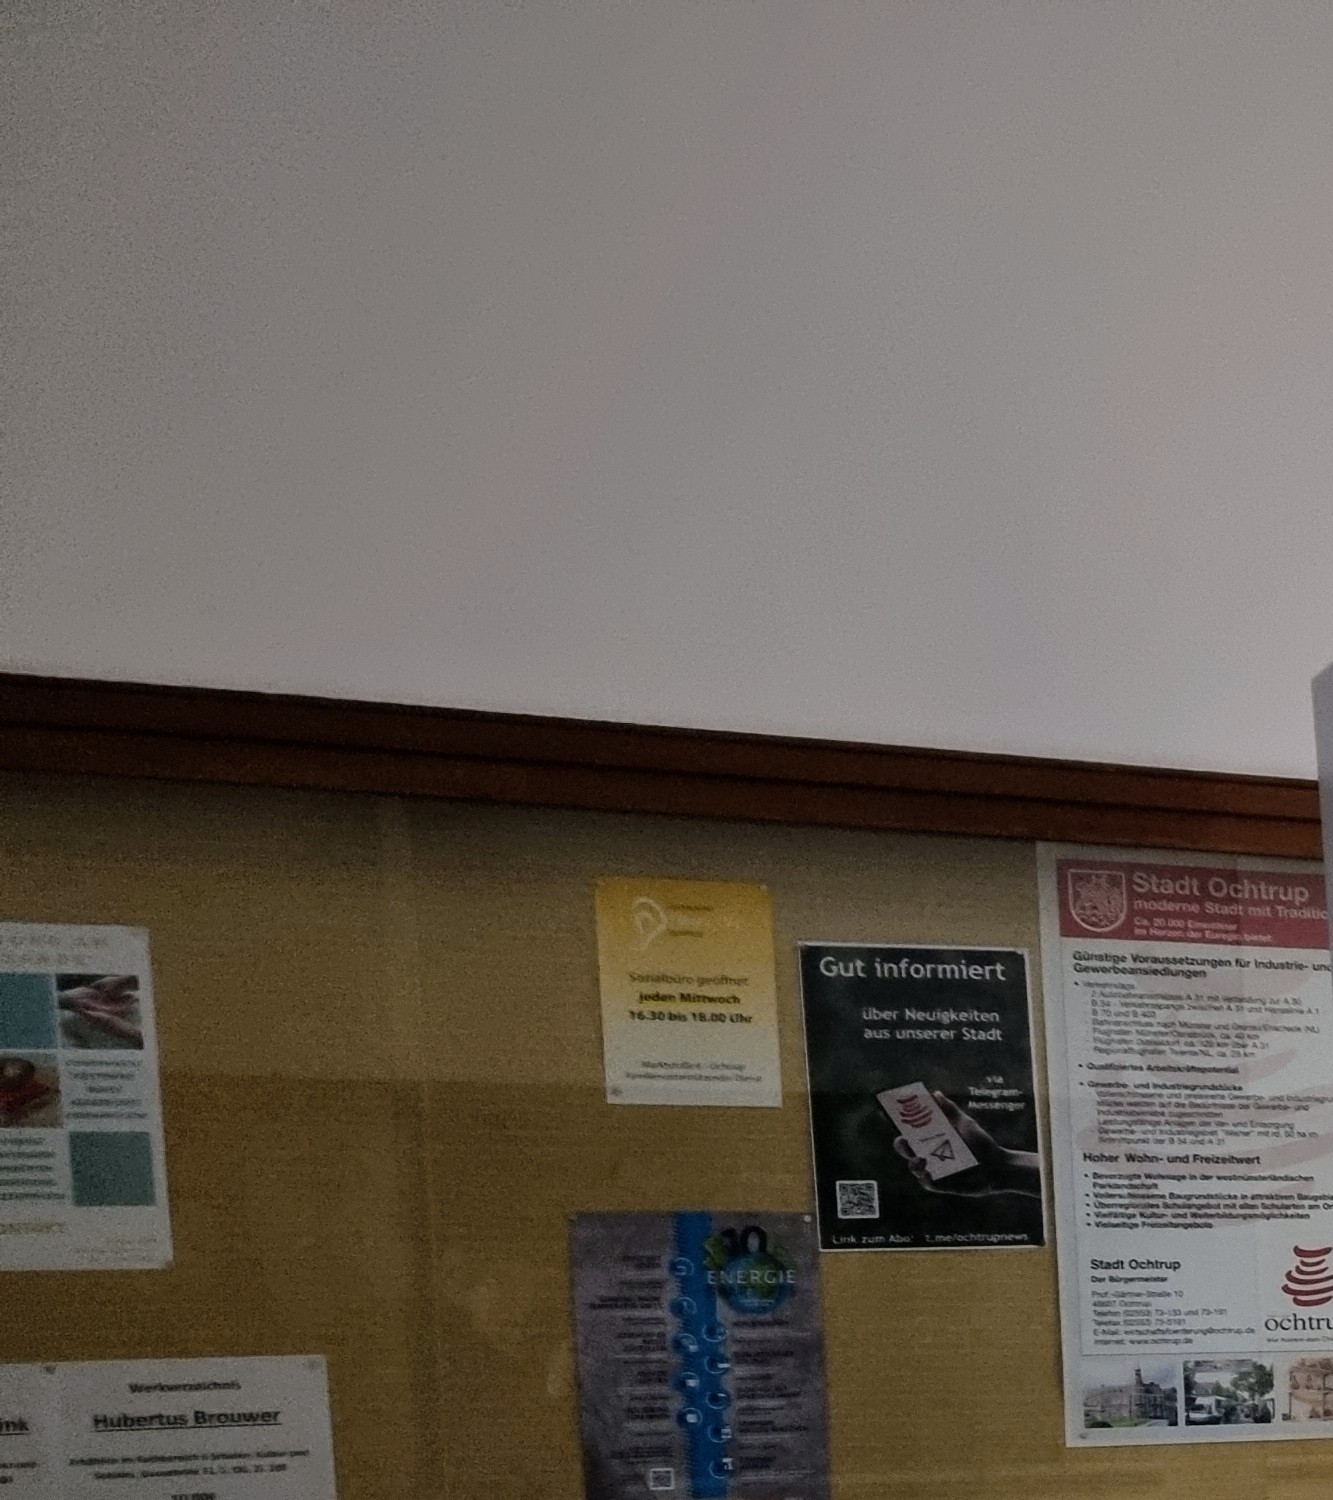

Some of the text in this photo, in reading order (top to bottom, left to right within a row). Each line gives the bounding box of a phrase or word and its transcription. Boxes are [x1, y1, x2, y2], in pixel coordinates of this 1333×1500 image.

[1133, 875, 1311, 906] Stadt Ochtrup
[1133, 899, 1200, 915] moderne
[1204, 901, 1244, 917] Stadt
[1247, 905, 1272, 918] mit
[820, 955, 1007, 982] Gut informiert
[1131, 953, 1232, 970] Voraussetzungen
[1234, 956, 1254, 969] für
[679, 992, 742, 1004] Mittwoch
[862, 1006, 1000, 1025] über Neuigkeiten
[863, 1028, 1004, 1042] aus unserer Stadt
[1083, 1152, 1120, 1163] Hoher
[1166, 1154, 1190, 1164] und
[1192, 1153, 1261, 1165] Freizeitwert
[1090, 1258, 1182, 1273] Stadt Ochtrup
[706, 1268, 798, 1285] ENERGIE
[93, 1408, 282, 1431] Hubertus Brouwer
